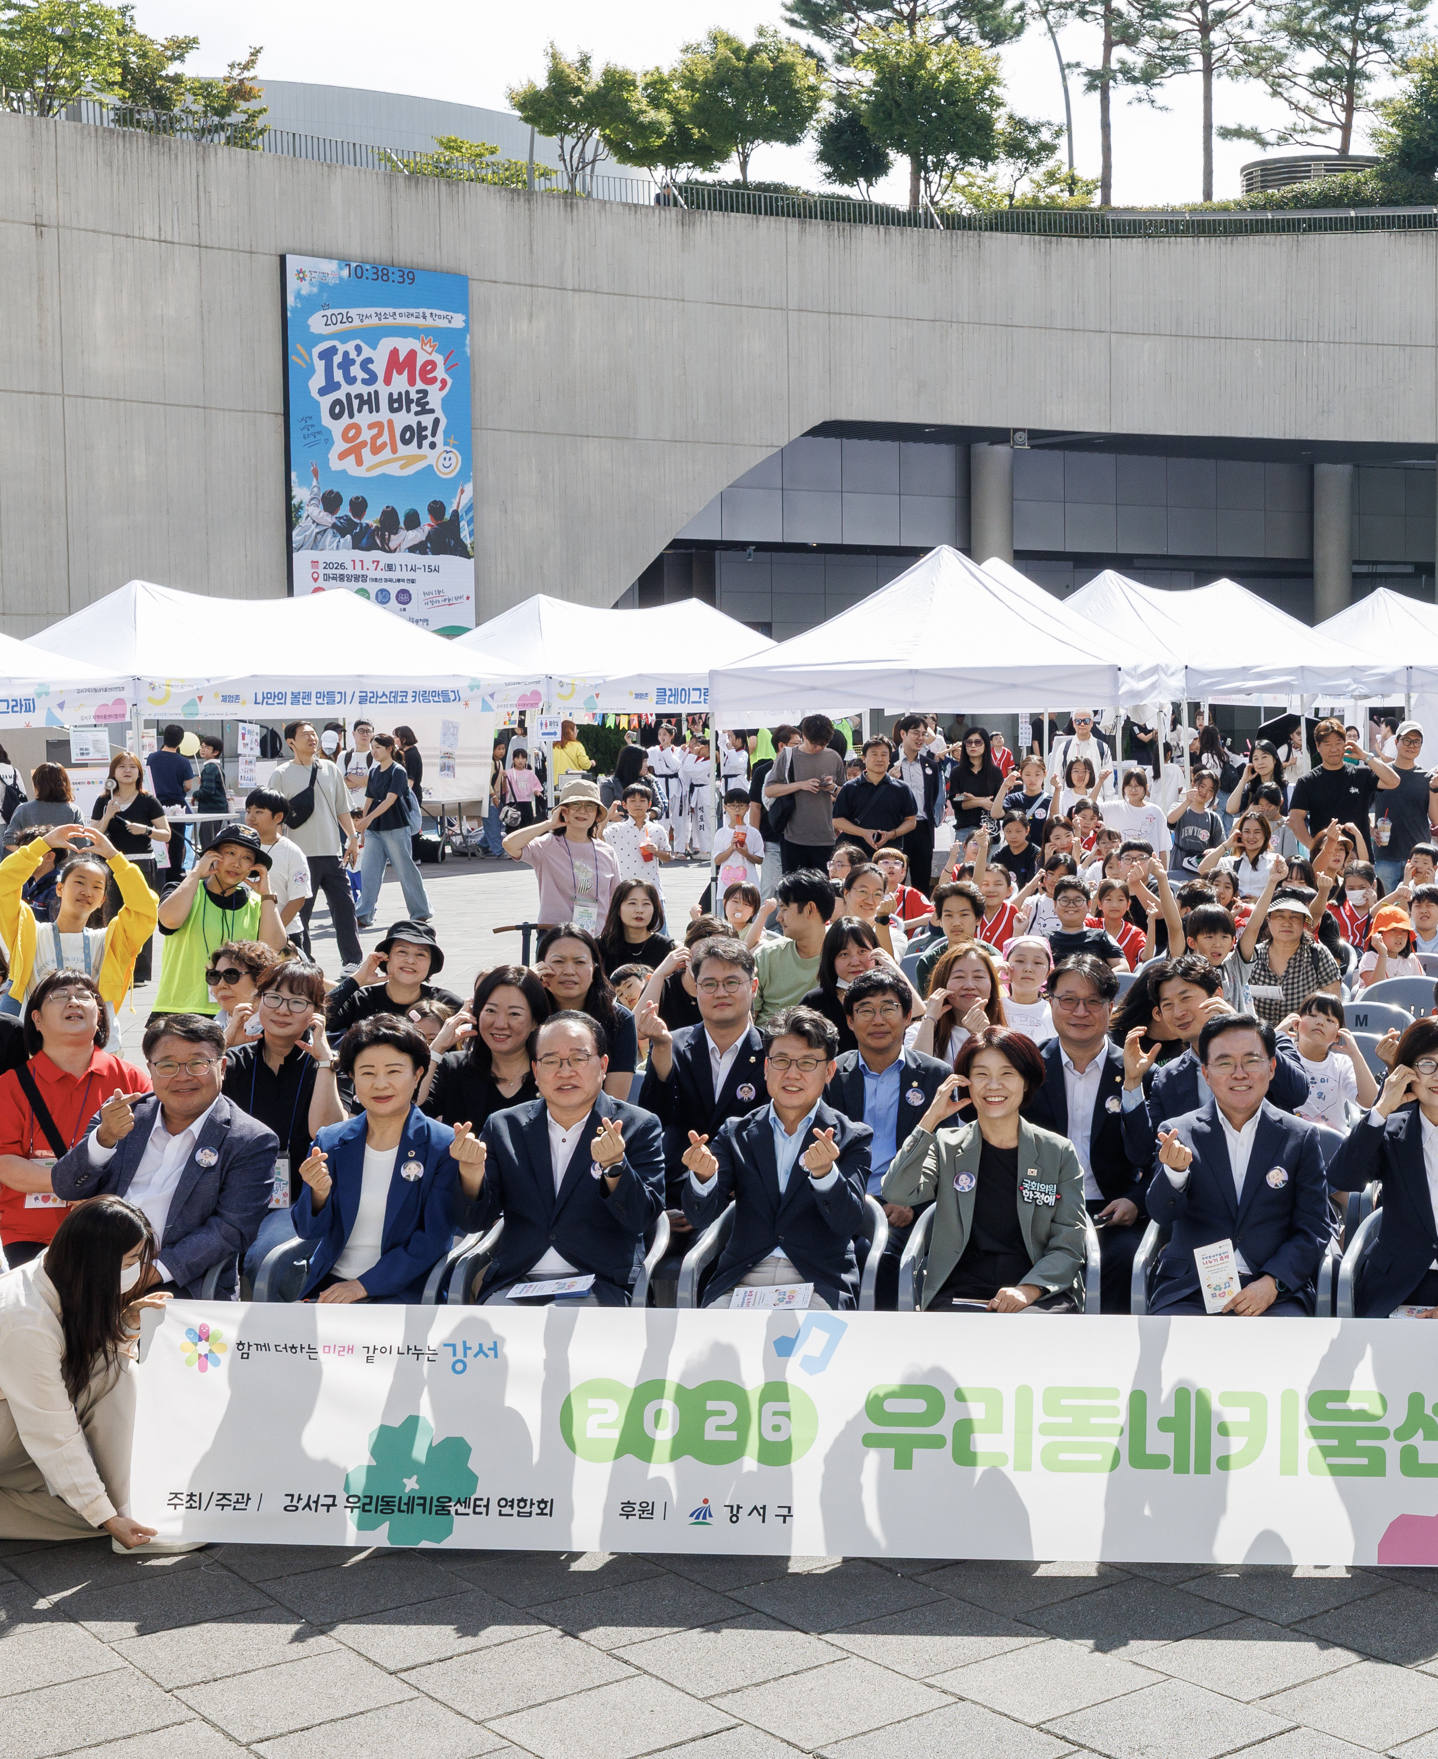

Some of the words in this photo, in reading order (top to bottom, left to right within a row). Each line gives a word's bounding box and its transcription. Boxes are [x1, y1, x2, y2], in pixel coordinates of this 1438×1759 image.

[345, 264, 416, 285] 10:38:39
[322, 311, 354, 327] 2026
[356, 313, 373, 321] 강서
[374, 311, 397, 322] 청소년
[399, 311, 428, 322] 미래교육
[429, 313, 454, 324] 한마당
[317, 343, 379, 397] It's
[383, 346, 448, 392] Me,
[329, 389, 380, 421] 이게
[388, 388, 436, 416] 바로
[337, 418, 398, 467] 우리
[400, 417, 441, 450] 야!
[322, 561, 348, 571] 2026.
[350, 560, 370, 571] 11.
[399, 563, 440, 574] 11시~15시
[322, 573, 369, 583] 마곡중앙광장
[220, 694, 241, 704] 체험존
[254, 691, 286, 706] 나만의
[290, 691, 312, 706] 볼펜
[315, 691, 347, 706] 만들기
[350, 691, 355, 705] /
[358, 691, 408, 705] 글라스데코
[411, 690, 461, 704] 키링만들기
[1355, 1014, 1368, 1027] M
[1022, 1179, 1057, 1195] 국회의원
[1022, 1189, 1056, 1206] 한정애
[236, 1340, 270, 1360] 함께
[273, 1343, 318, 1361] 더하는
[322, 1344, 355, 1357] 미래
[362, 1345, 392, 1364] 같이
[396, 1344, 438, 1362] 나누는
[443, 1340, 499, 1375] 강서
[585, 1397, 794, 1443] 2026
[167, 1491, 252, 1512] 주최/주관
[283, 1493, 338, 1514] 강서구
[343, 1495, 490, 1517] 우리동네키움센터
[496, 1496, 554, 1518] 연합회
[618, 1499, 655, 1520] 후원
